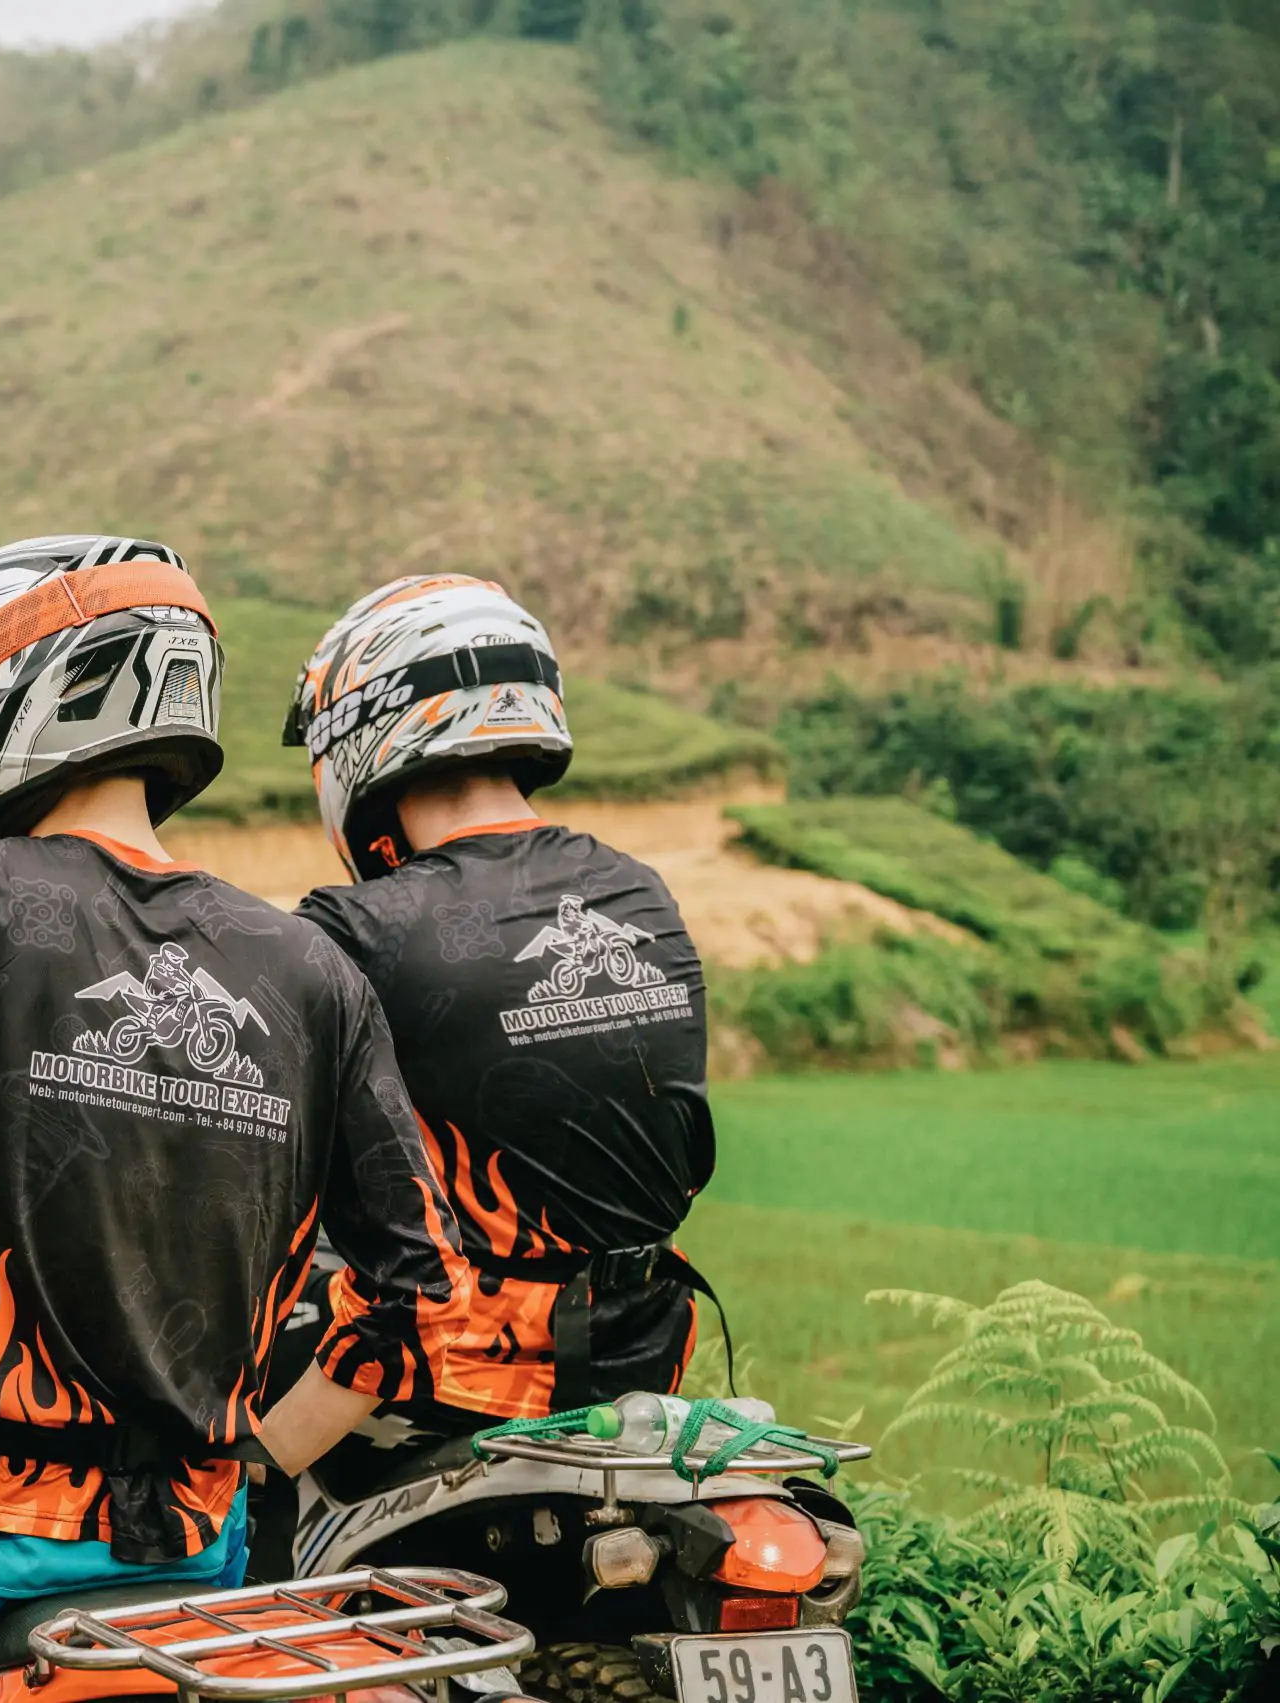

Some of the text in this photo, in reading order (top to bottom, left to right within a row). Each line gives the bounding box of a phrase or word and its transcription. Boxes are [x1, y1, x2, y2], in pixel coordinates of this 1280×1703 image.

[499, 984, 689, 1033] MOTORBIKE TOUR EXPERT
[29, 1082, 55, 1099] Web:
[58, 1088, 185, 1124] motorbiketourexpert.com
[196, 1112, 213, 1128] Tel:
[215, 1119, 234, 1133] +84
[236, 1121, 254, 1136] 979
[30, 1050, 290, 1126] MOTORBIKE TOUR EXPERT
[700, 1643, 833, 1703] 59-A3
